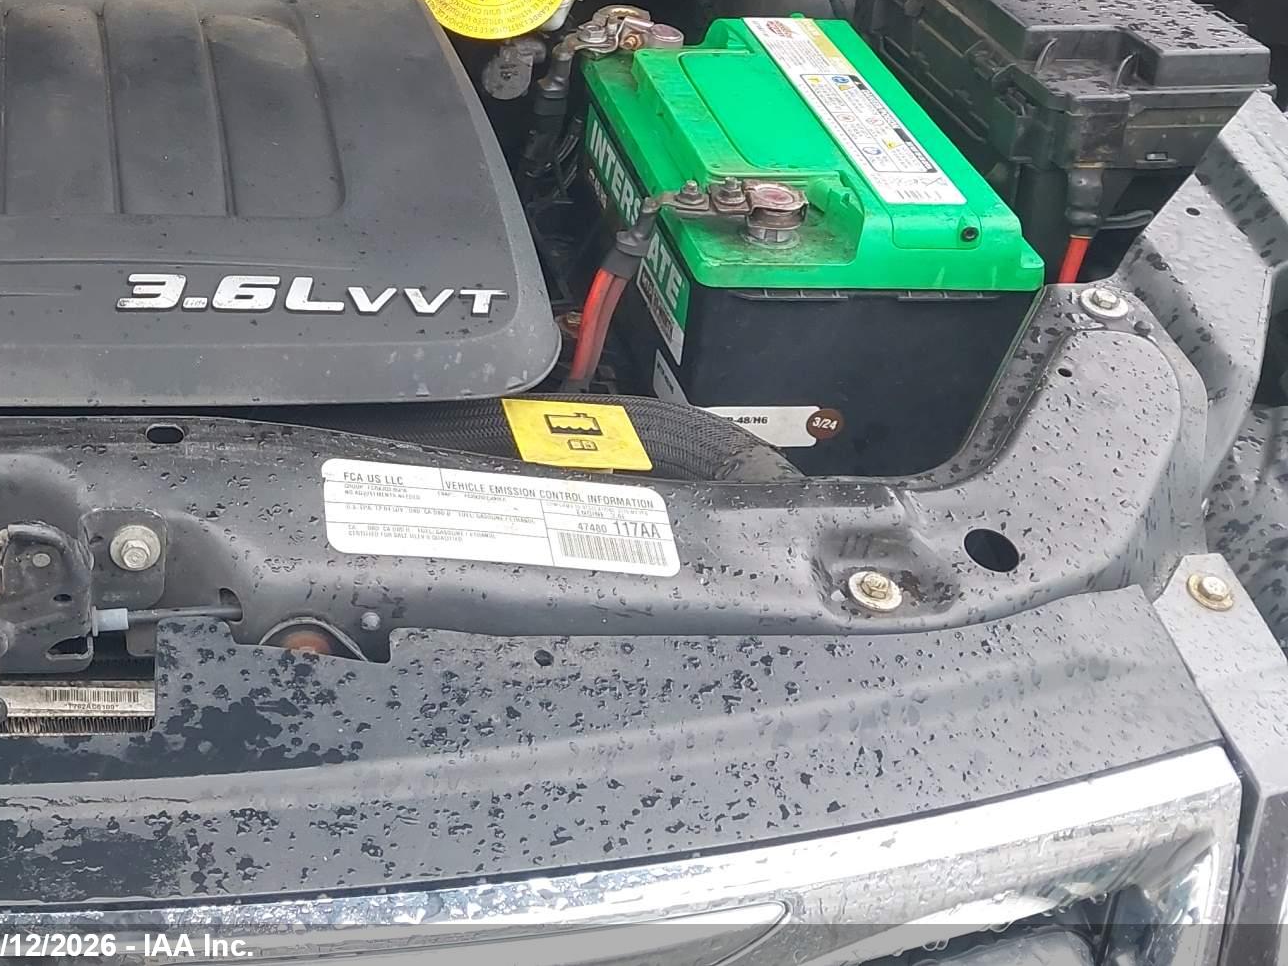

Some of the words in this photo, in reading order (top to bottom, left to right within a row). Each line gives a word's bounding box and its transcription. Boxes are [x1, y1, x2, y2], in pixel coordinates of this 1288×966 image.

[812, 417, 838, 430] 3/24
[344, 472, 363, 482] FCA
[367, 474, 381, 484] US
[385, 476, 404, 486] LLC
[446, 481, 485, 493] VEHICLE
[489, 485, 536, 498] EMISSION
[540, 489, 584, 502] CONTROL
[587, 495, 654, 509] INFORMATION
[614, 520, 661, 539] 117AA
